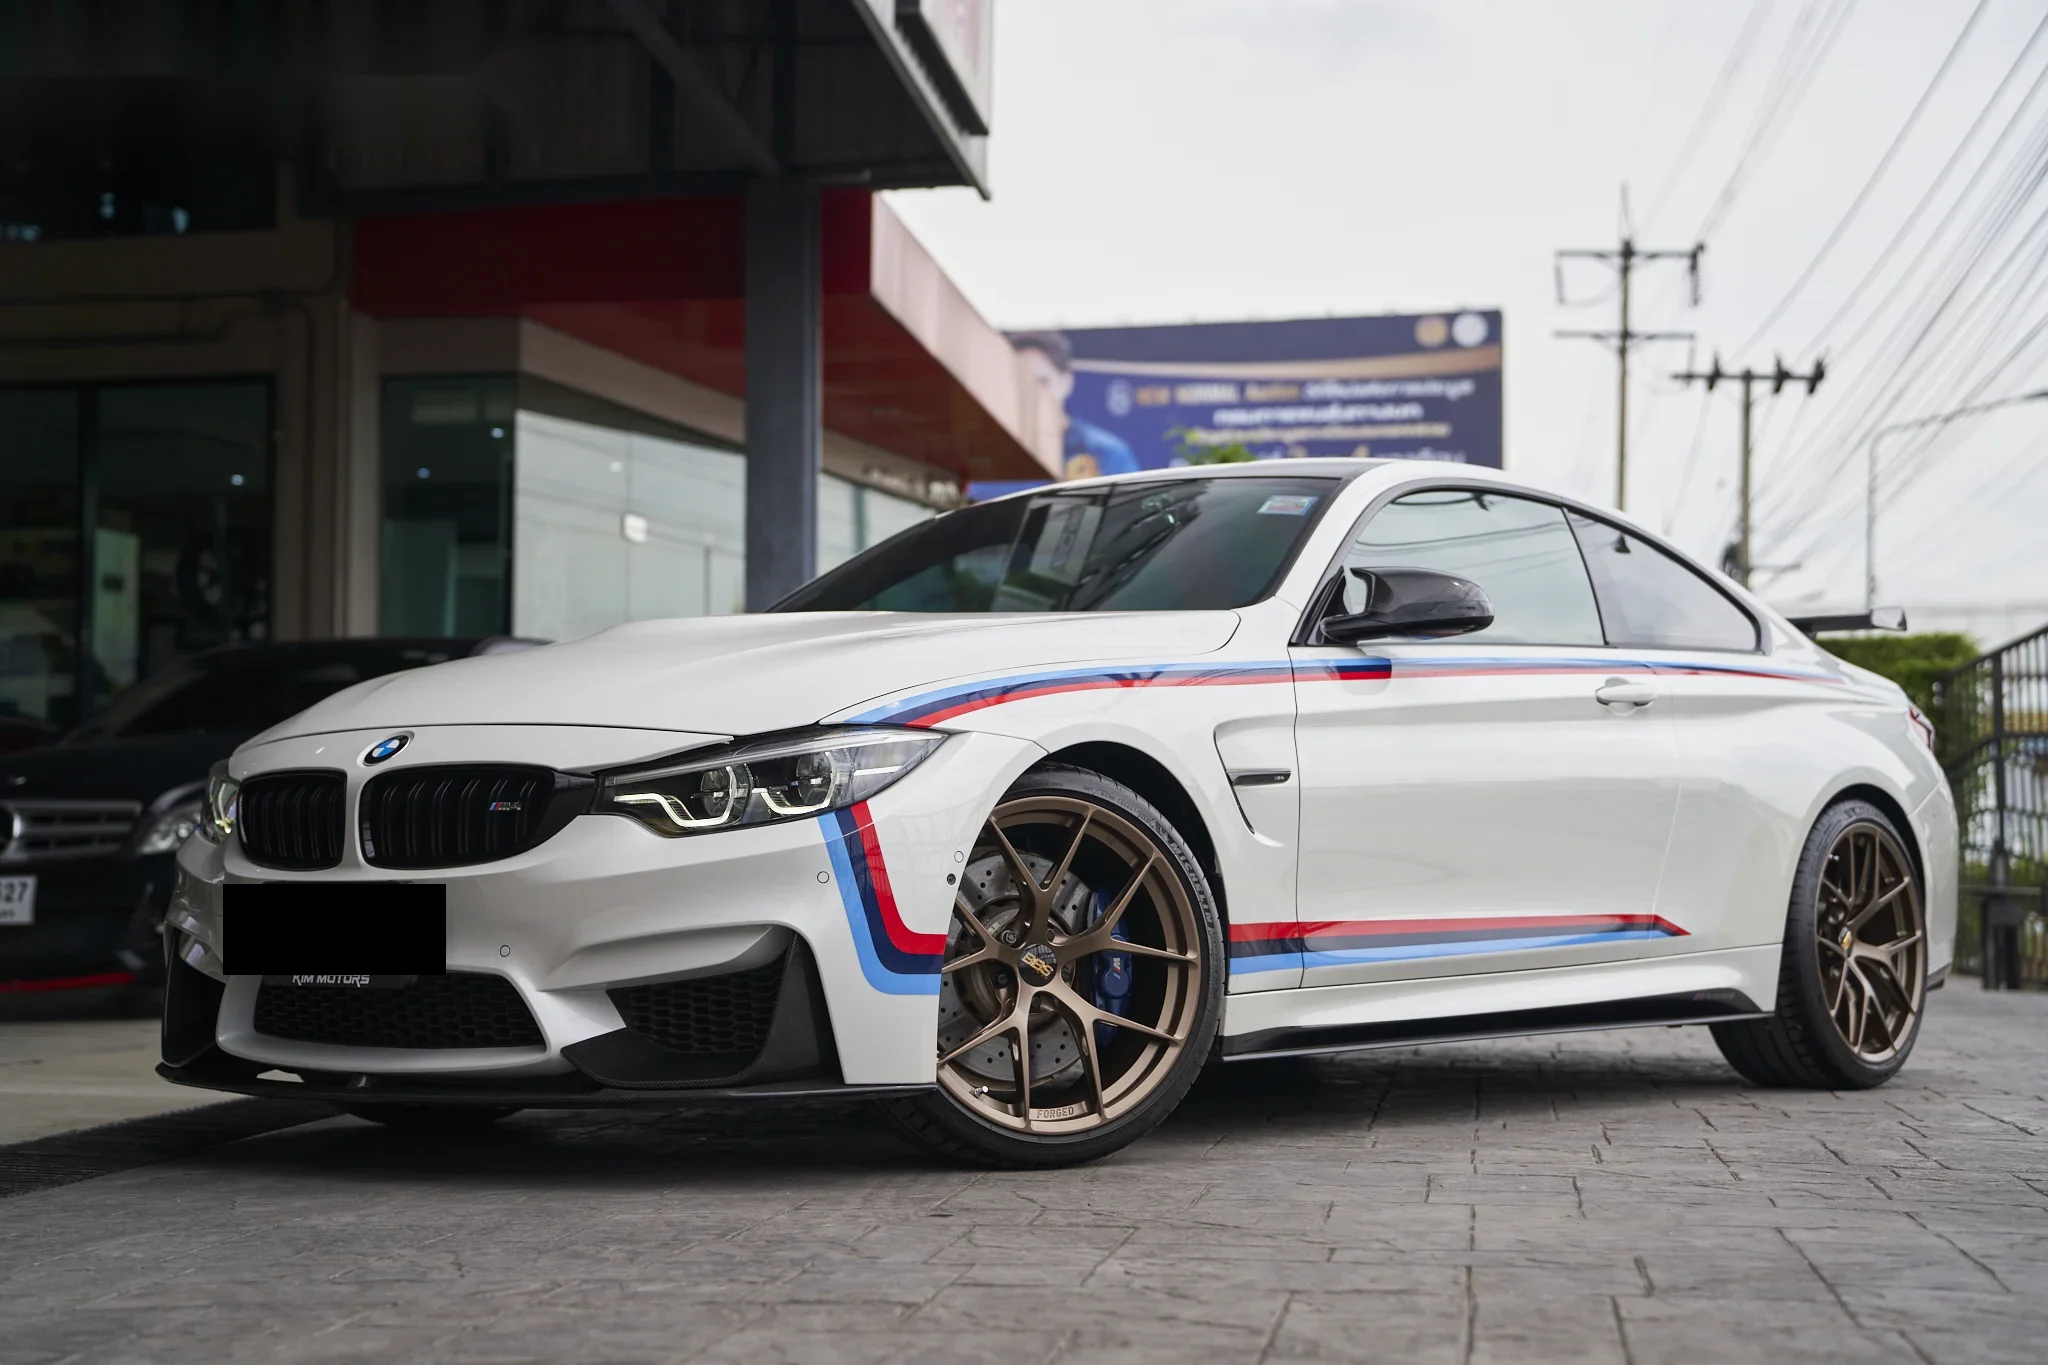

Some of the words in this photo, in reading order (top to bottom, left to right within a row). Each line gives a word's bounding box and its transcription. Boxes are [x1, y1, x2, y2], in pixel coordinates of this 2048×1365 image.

[0, 881, 28, 904] 27
[1169, 842, 1213, 925] MICHELIN
[1022, 952, 1053, 977] BBS
[292, 974, 314, 986] KIM
[316, 974, 370, 988] MOTORS
[1037, 1106, 1075, 1119] FORGED
